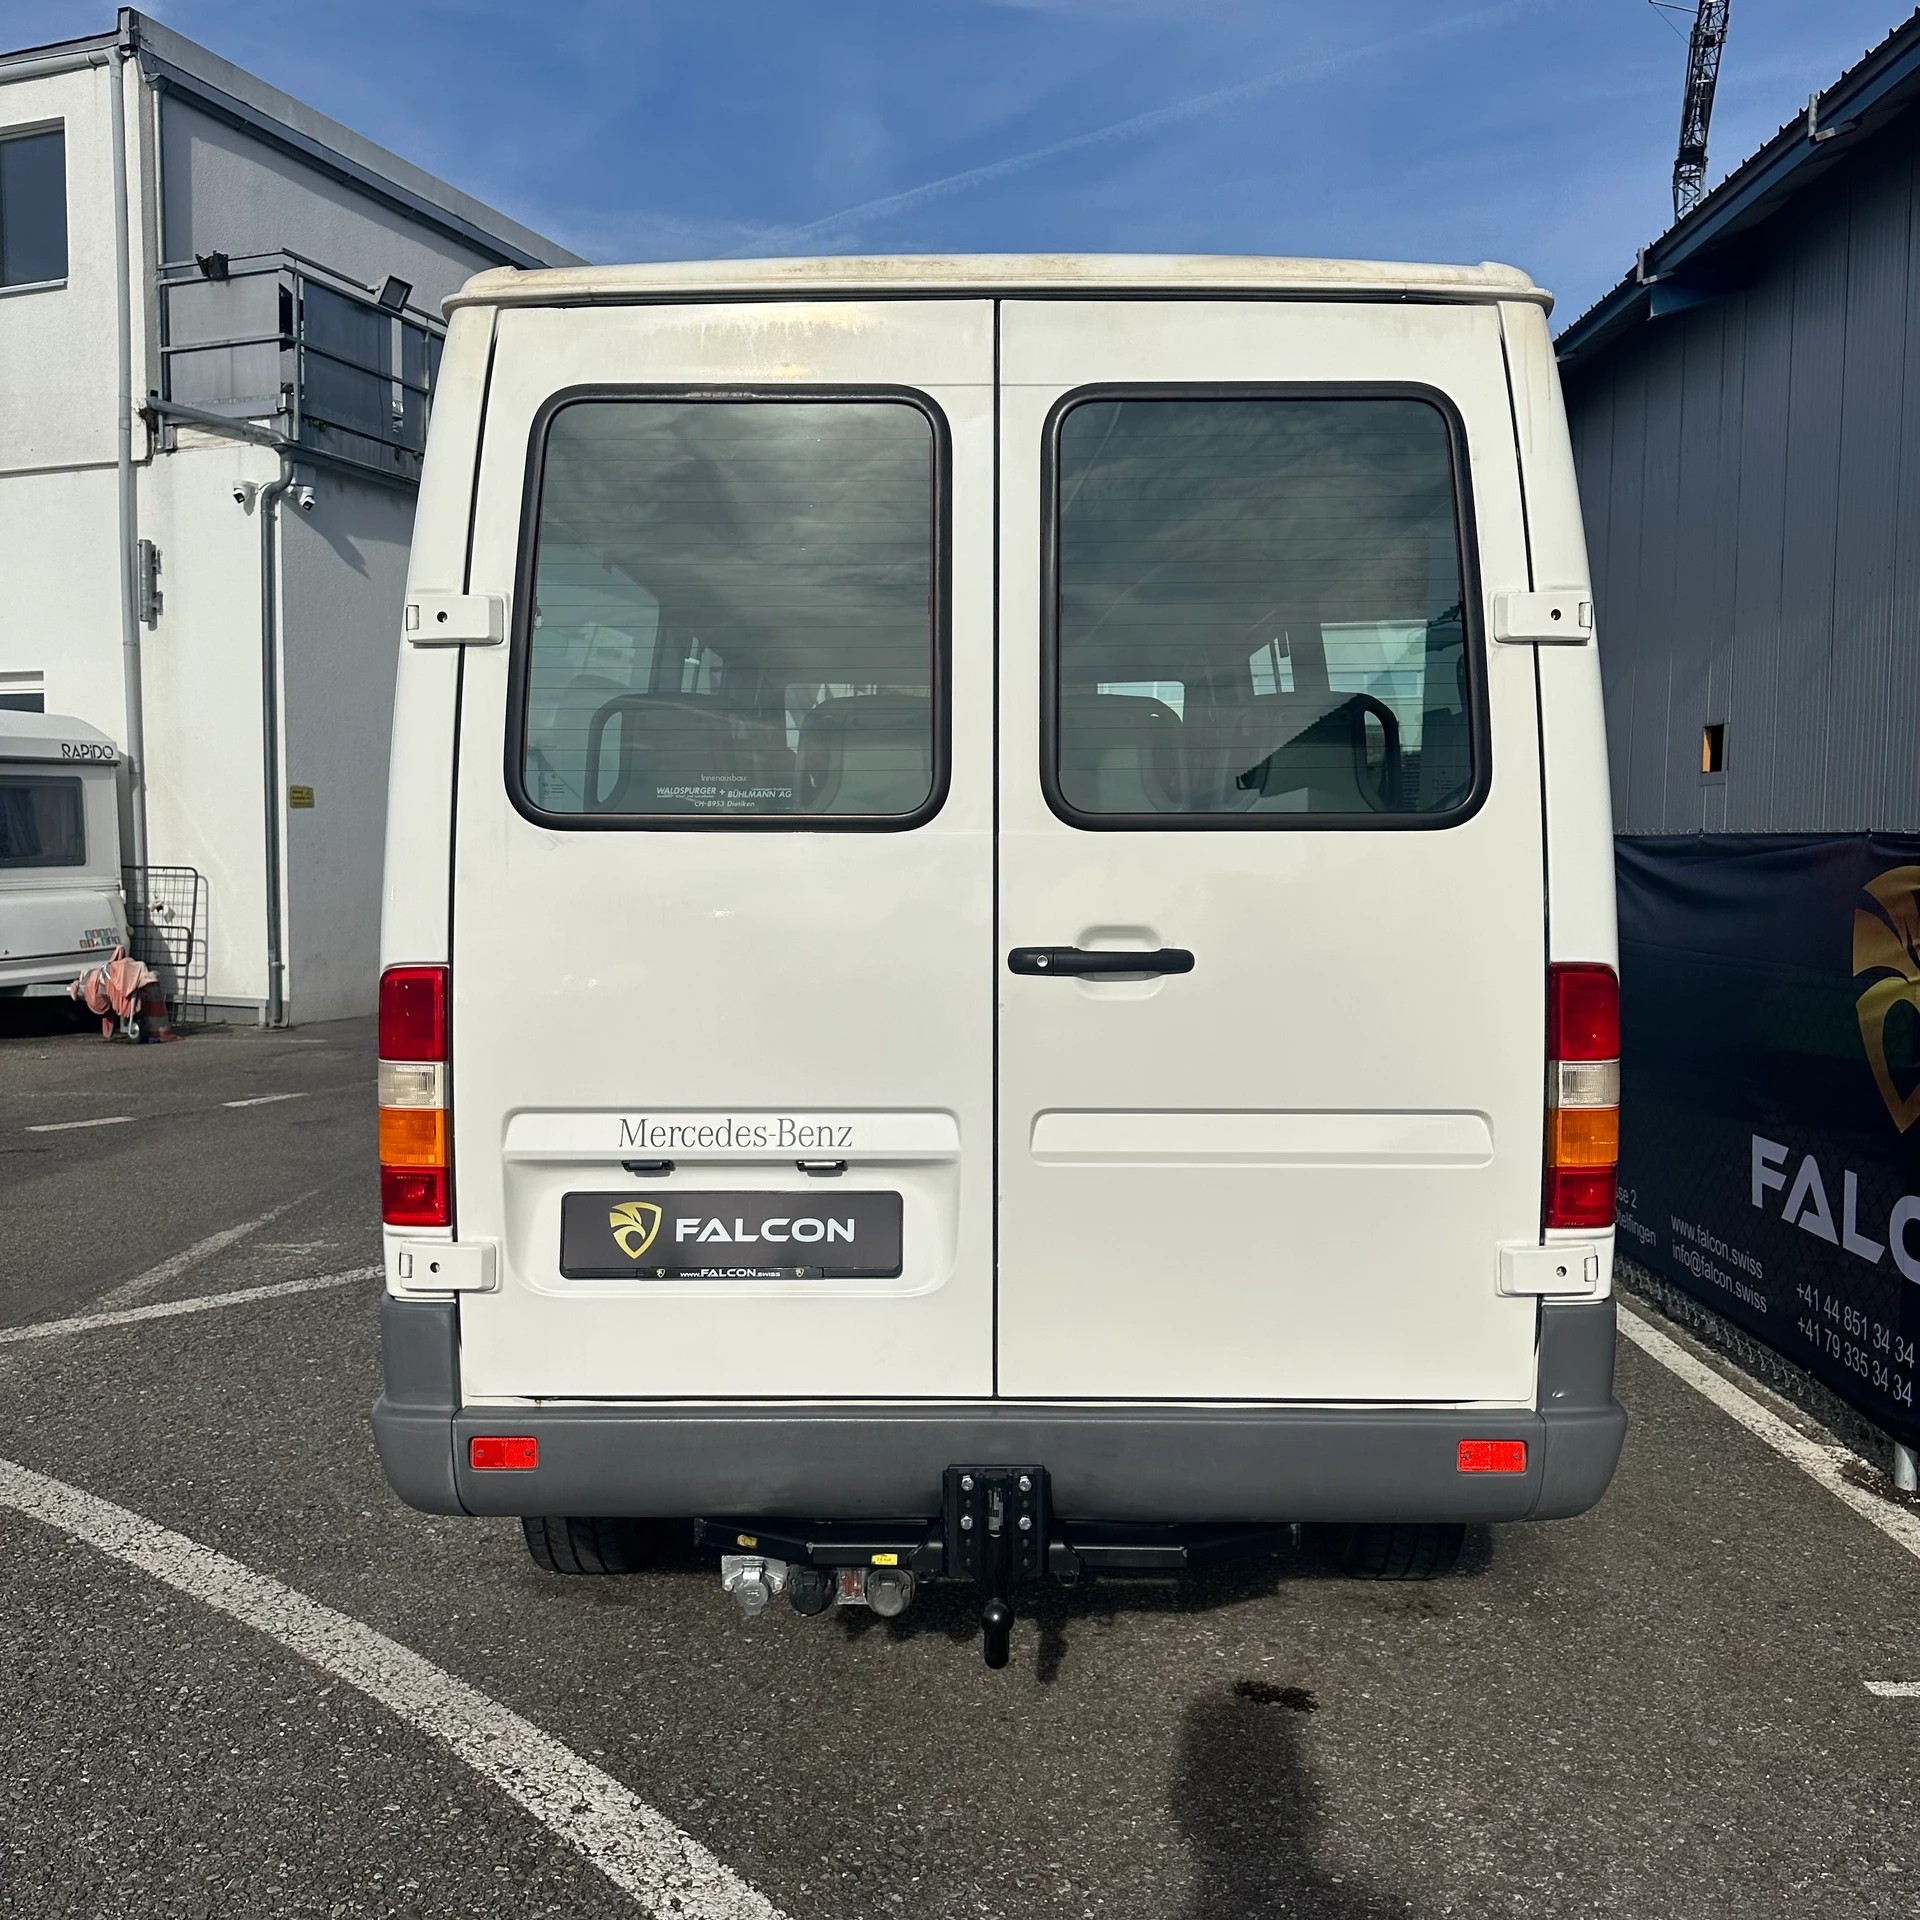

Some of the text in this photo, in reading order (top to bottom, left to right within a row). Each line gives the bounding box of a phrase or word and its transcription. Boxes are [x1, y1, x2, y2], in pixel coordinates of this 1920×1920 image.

[656, 786, 717, 795] WALDSPURGER
[727, 788, 776, 798] BÜHLMANN
[778, 790, 793, 798] AG
[618, 1118, 853, 1148] Mercedes-Benz
[1630, 1189, 1637, 1209] 2
[675, 1218, 855, 1243] FALCON
[1670, 1214, 1763, 1279] www.falcon.swiss
[1672, 1239, 1767, 1313] info@falcon.swiss
[1796, 1283, 1915, 1369] +41 44 851 34 34
[1797, 1316, 1912, 1408] +41 79 335 34 34
